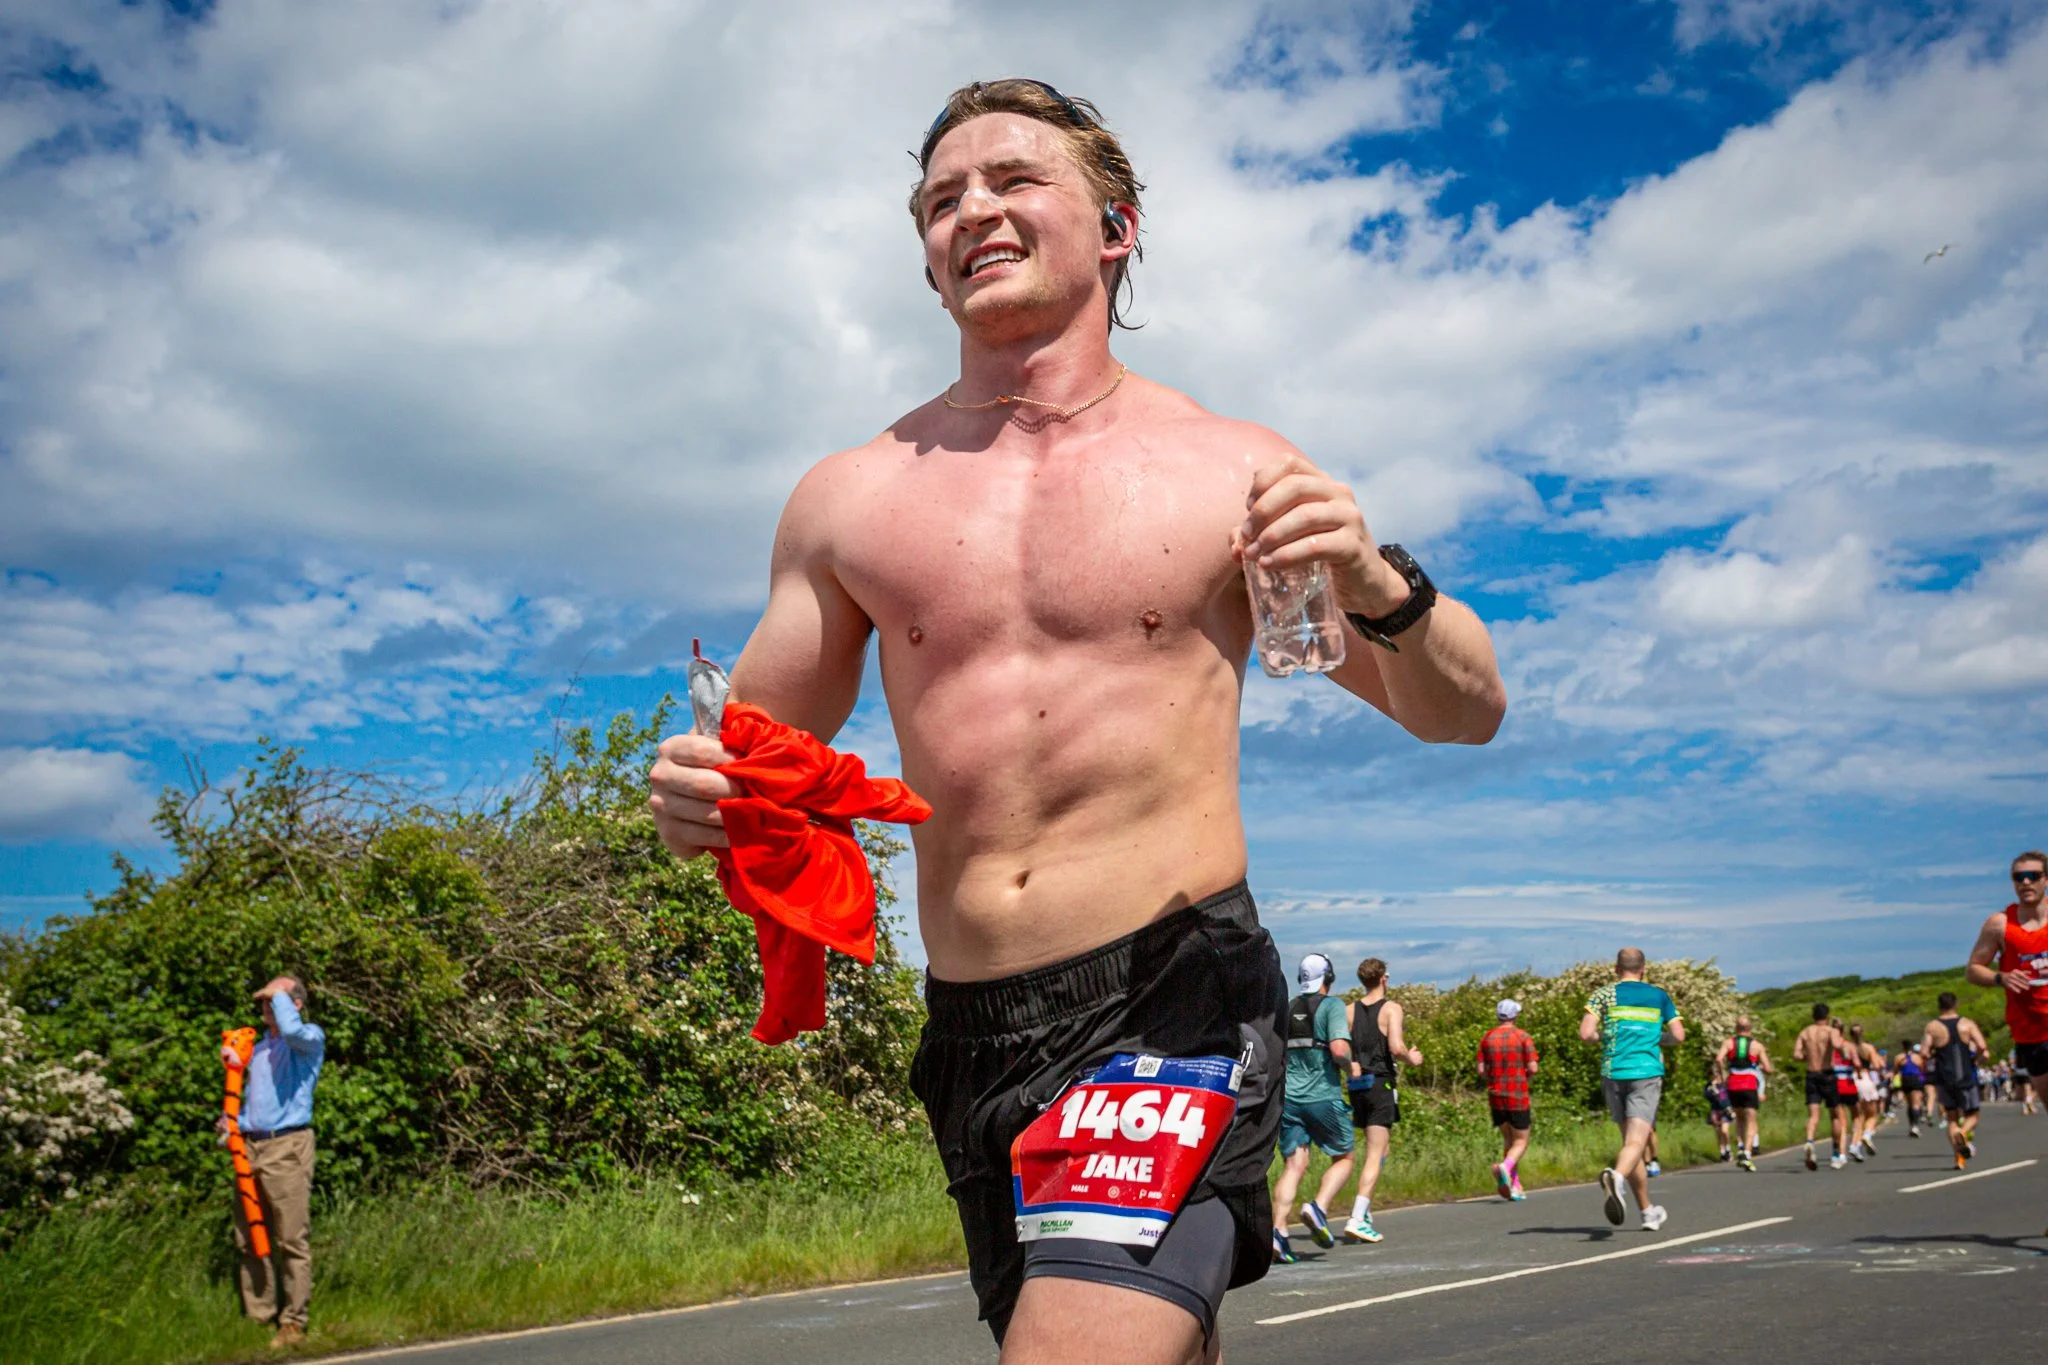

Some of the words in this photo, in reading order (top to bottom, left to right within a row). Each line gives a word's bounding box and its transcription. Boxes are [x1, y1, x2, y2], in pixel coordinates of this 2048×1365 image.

[1059, 1090, 1206, 1148] 1464
[1081, 1154, 1154, 1183] JAKE
[1071, 1184, 1089, 1193] MALE
